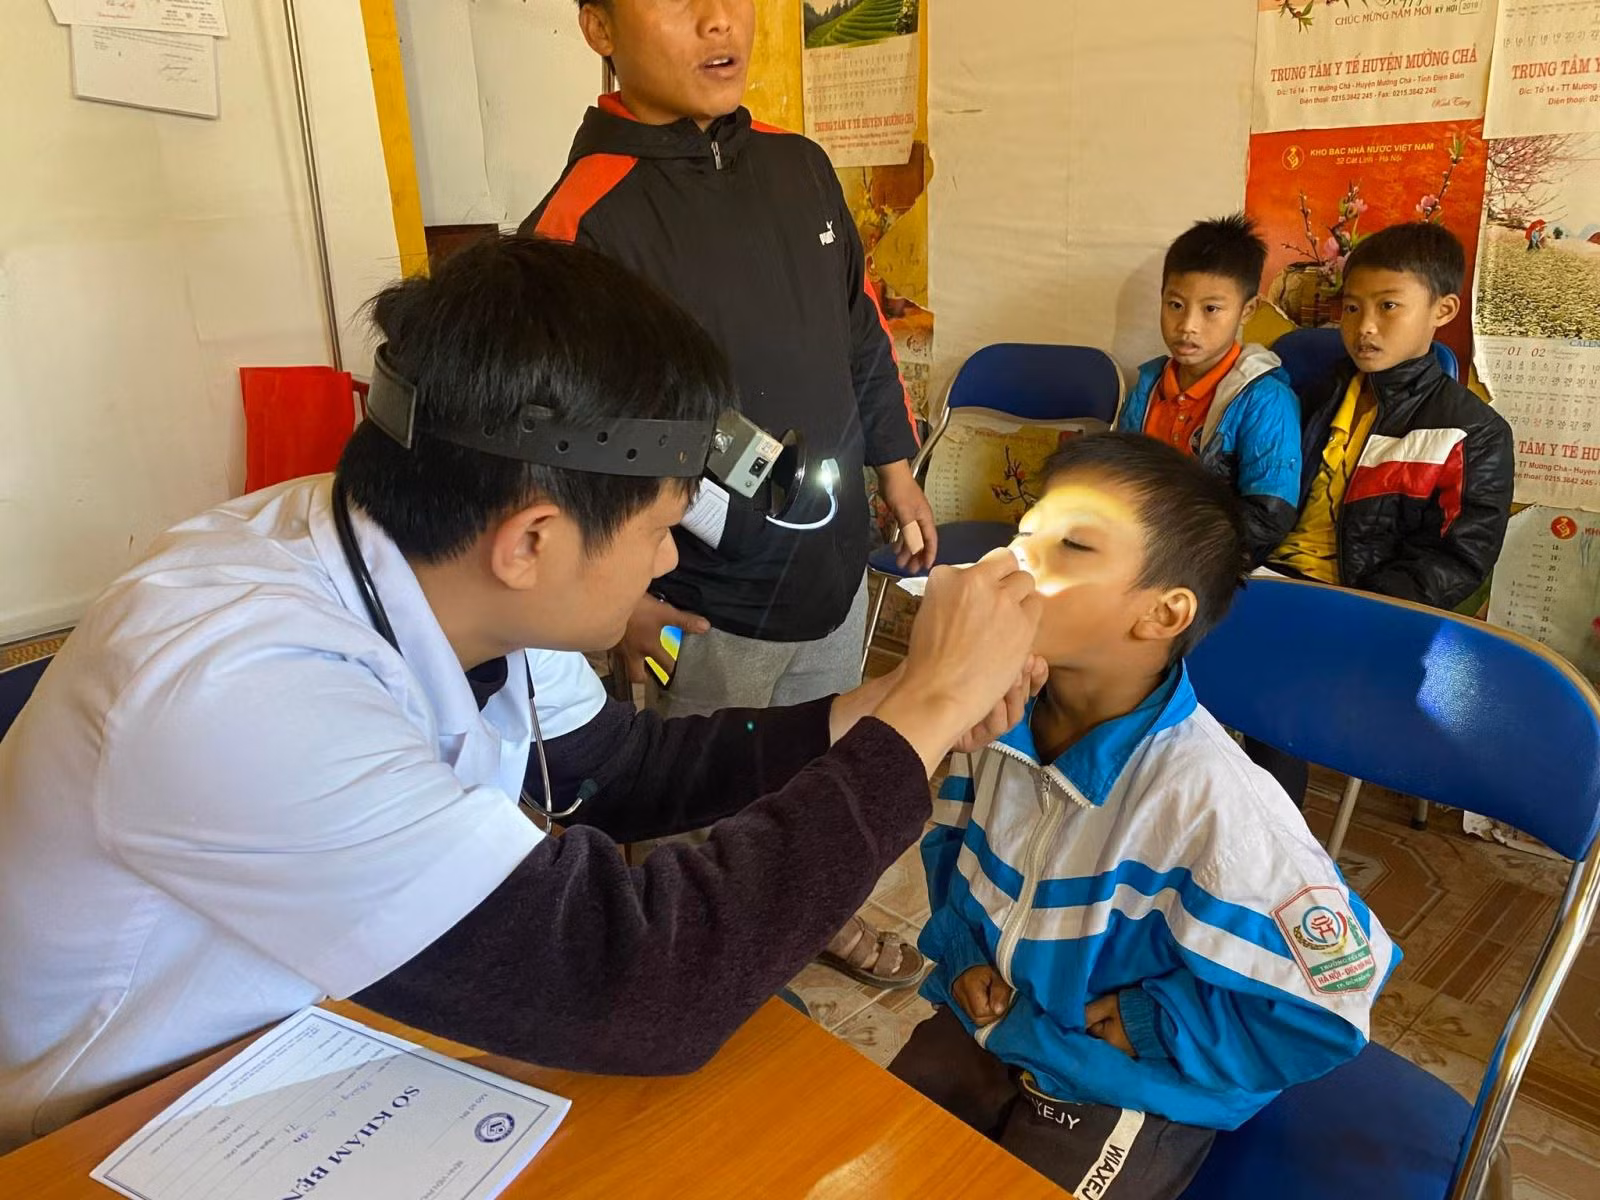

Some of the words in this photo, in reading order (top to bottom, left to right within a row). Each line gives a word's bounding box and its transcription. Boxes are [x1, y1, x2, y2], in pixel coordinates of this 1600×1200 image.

[1271, 65, 1307, 82] TRUNG
[1308, 60, 1332, 79] TÂM
[1334, 61, 1343, 76] Y
[1345, 52, 1361, 75] TẾ
[1361, 51, 1403, 75] HUYỆN
[1405, 47, 1449, 70] MƯỜNG
[1512, 61, 1557, 81] TRUNG
[1560, 54, 1591, 75] TÂM
[1310, 148, 1327, 157] KHO
[1347, 145, 1365, 155] NHÀ
[1414, 142, 1435, 151] NAM
[1507, 346, 1521, 356] 01
[1531, 347, 1546, 358] 02
[1519, 437, 1545, 456] TÂM
[1548, 443, 1558, 456] Y
[1562, 439, 1580, 459] TẾ
[328, 1111, 392, 1164] KHÁM
